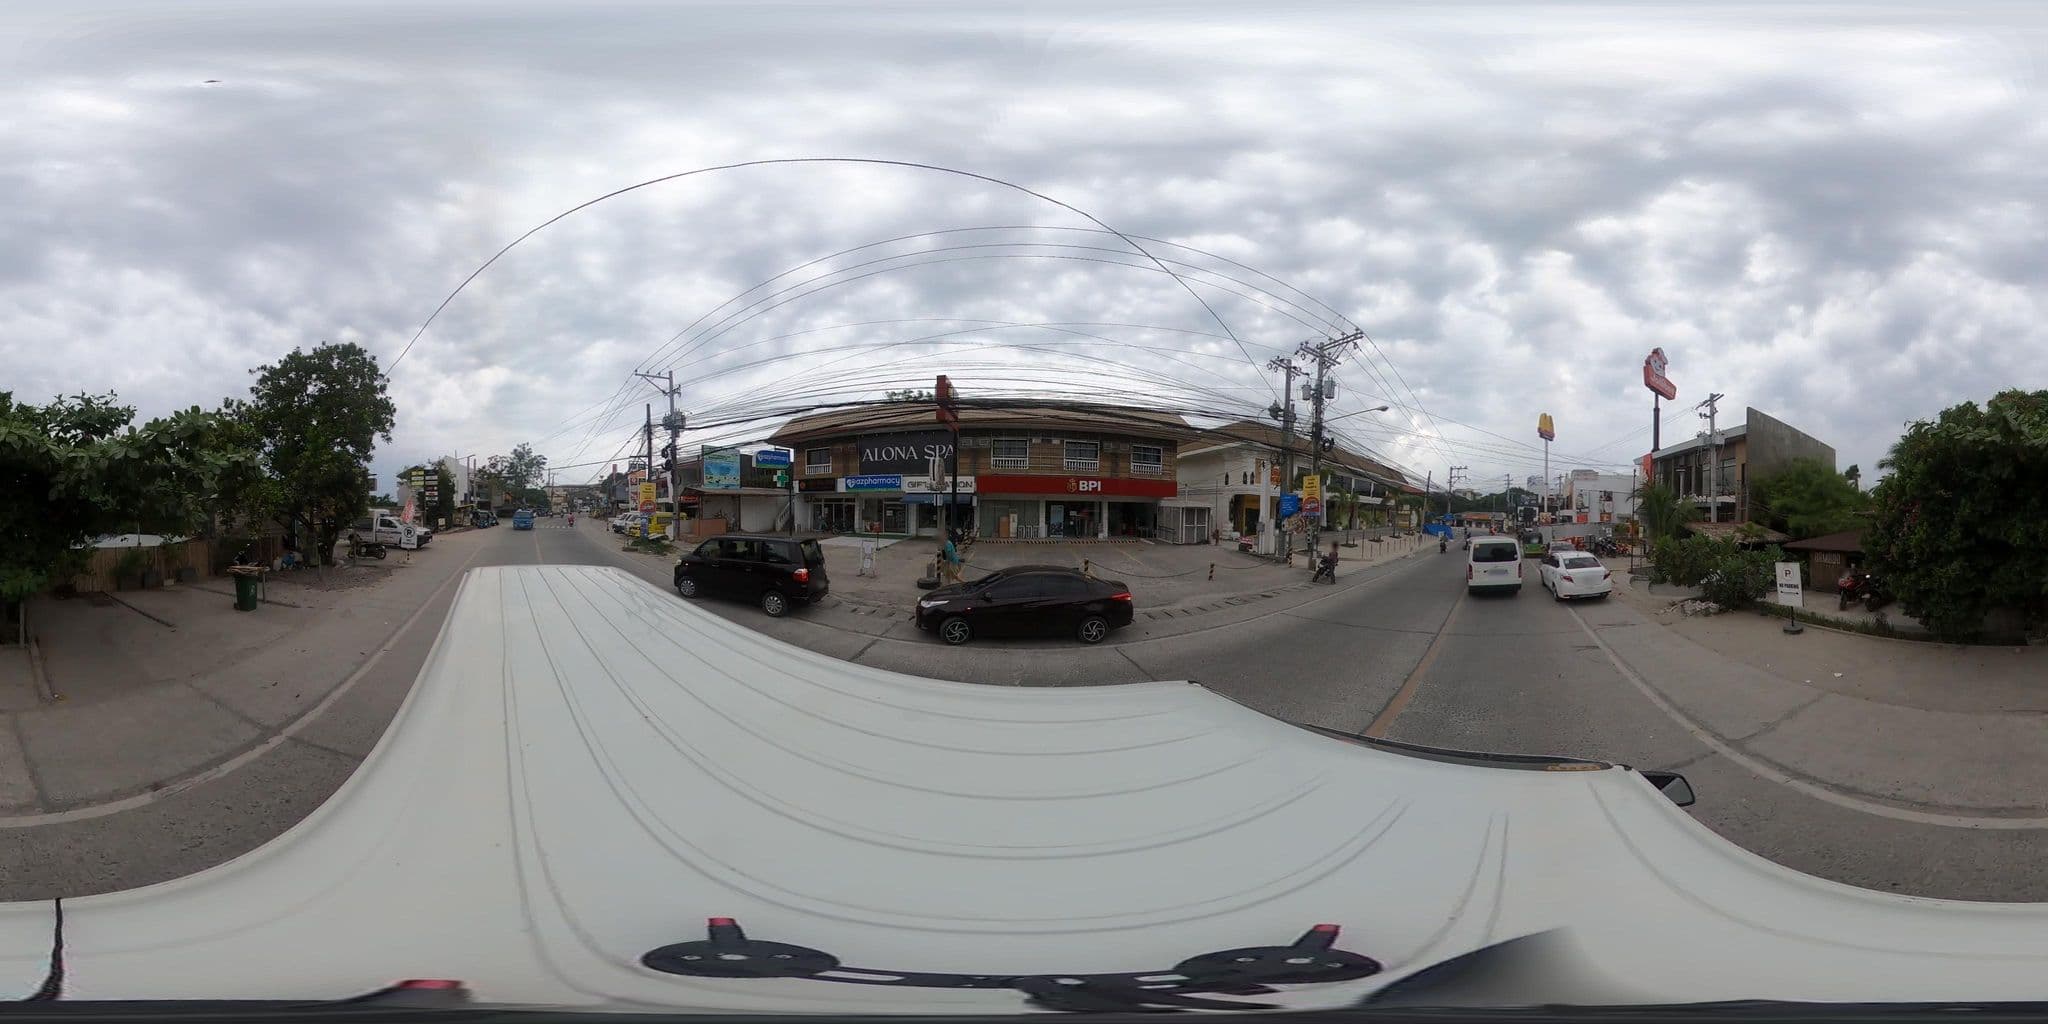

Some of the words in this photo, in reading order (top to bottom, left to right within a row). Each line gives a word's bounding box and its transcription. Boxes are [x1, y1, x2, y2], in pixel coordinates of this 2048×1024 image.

[862, 446, 918, 462] ALONA
[924, 444, 953, 460] SPA
[856, 476, 900, 487] azpharmacy
[1079, 480, 1101, 491] BPI
